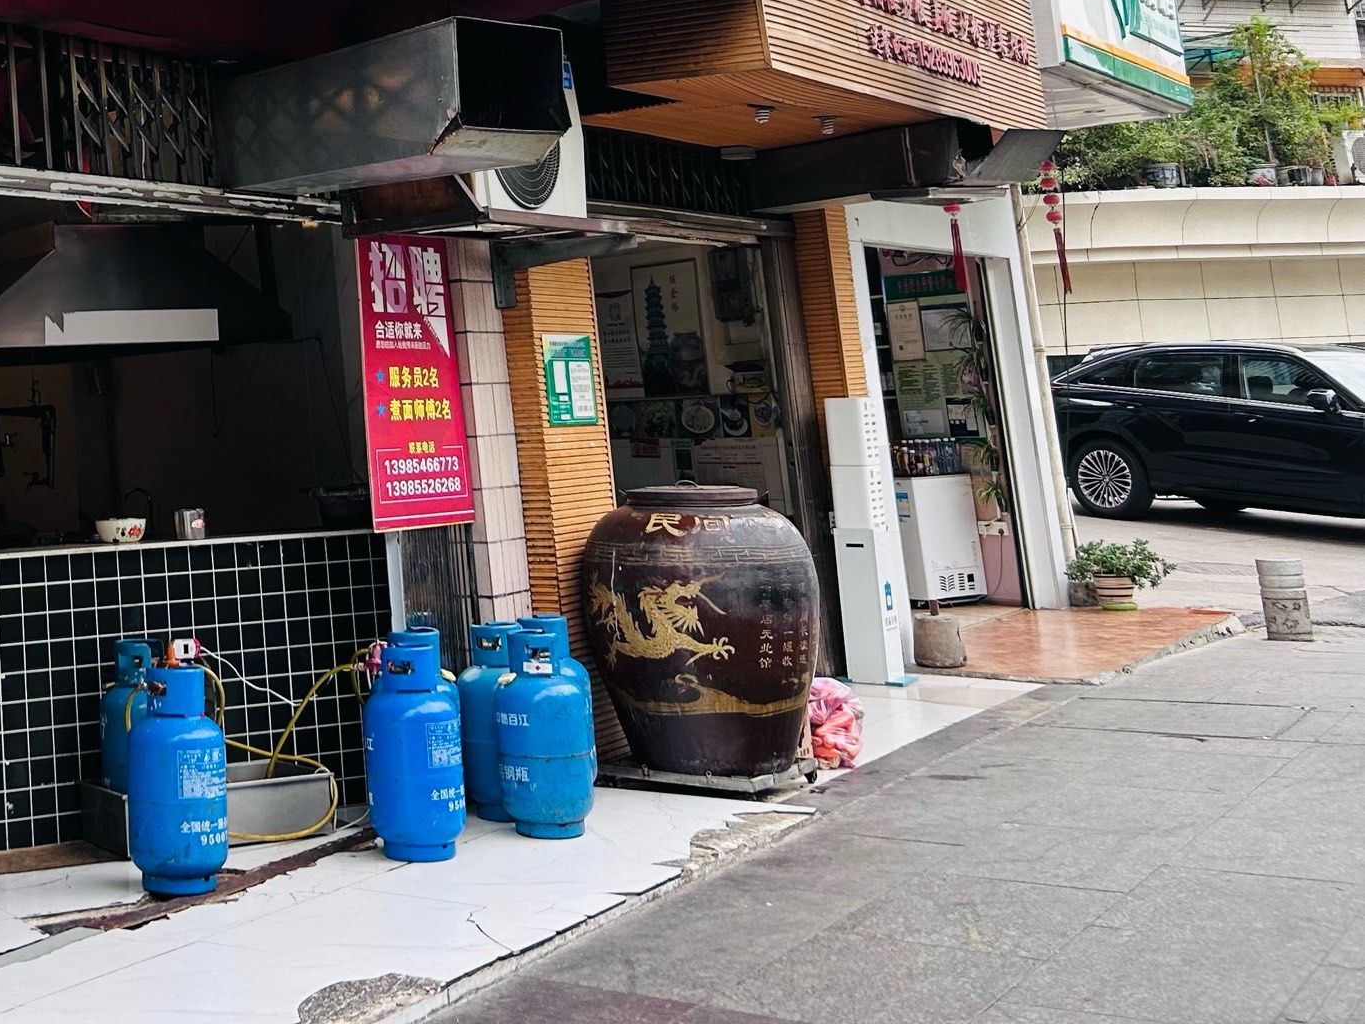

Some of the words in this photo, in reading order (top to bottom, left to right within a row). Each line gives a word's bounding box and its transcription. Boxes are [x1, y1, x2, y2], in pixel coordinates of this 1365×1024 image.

[369, 241, 446, 317] 招聘
[375, 320, 423, 339] 合适你就来
[389, 365, 439, 388] 服务员2名
[389, 397, 452, 421] 煮面师傅2名
[384, 456, 459, 475] 13985466773
[386, 477, 462, 496] 13985526268
